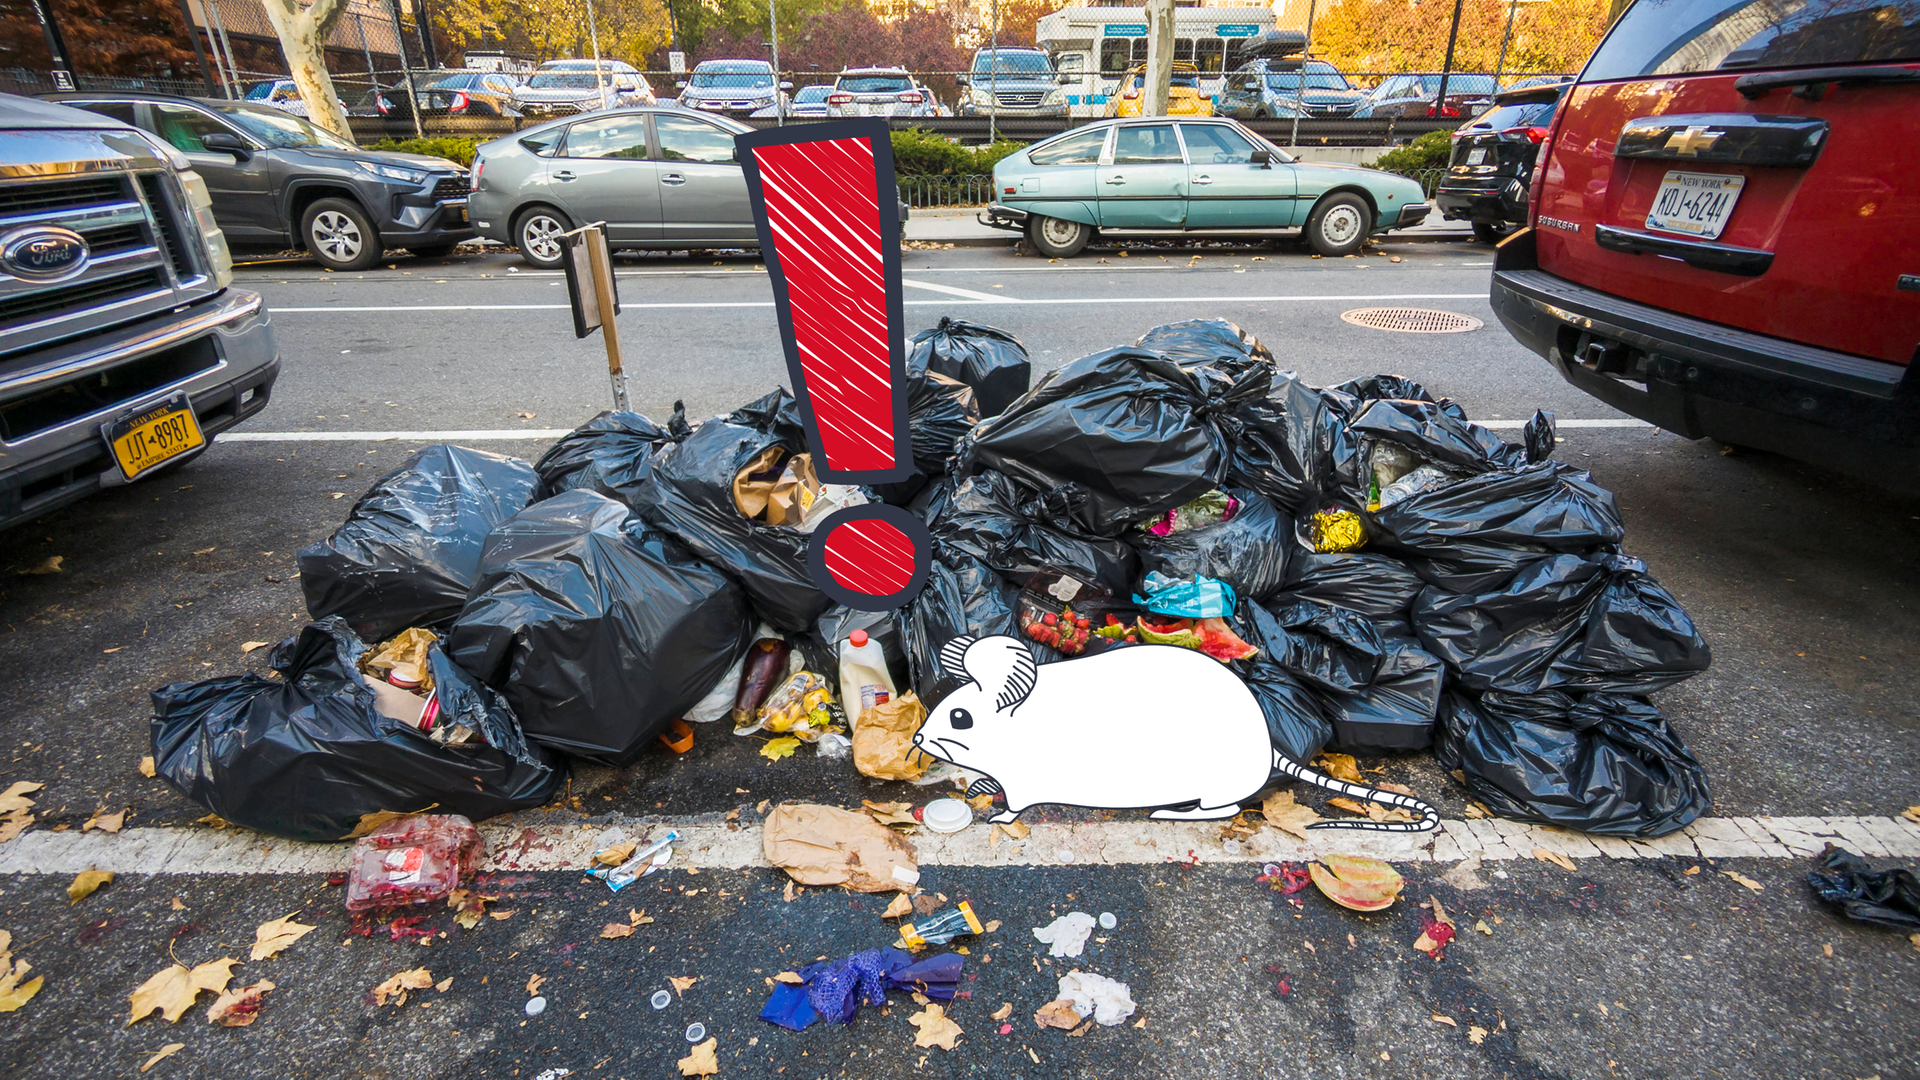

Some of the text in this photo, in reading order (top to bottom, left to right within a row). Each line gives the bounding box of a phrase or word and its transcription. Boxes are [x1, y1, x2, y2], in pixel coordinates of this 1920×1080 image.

[1680, 177, 1724, 189] NEW YORK
[1538, 215, 1580, 232] SUBURBAN
[30, 240, 72, 265] Ford
[129, 406, 170, 430] NEW YORK
[141, 443, 184, 467] EMPIRE STATE
